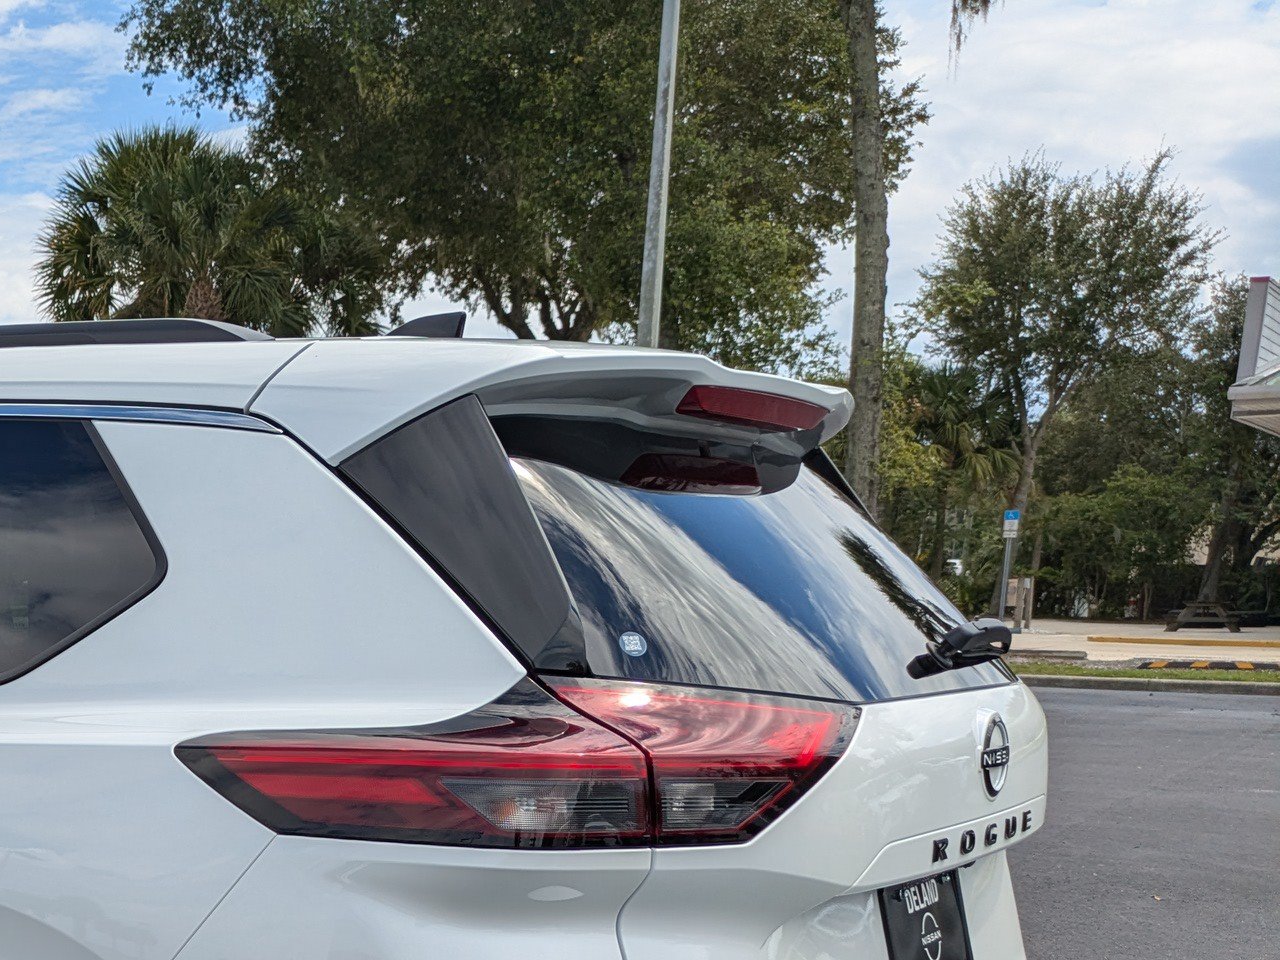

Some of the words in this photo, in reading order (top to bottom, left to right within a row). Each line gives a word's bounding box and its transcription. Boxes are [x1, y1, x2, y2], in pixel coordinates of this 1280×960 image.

[932, 810, 1032, 863] ROGUE
[904, 879, 939, 914] DELAND
[921, 930, 942, 946] NISSAN
